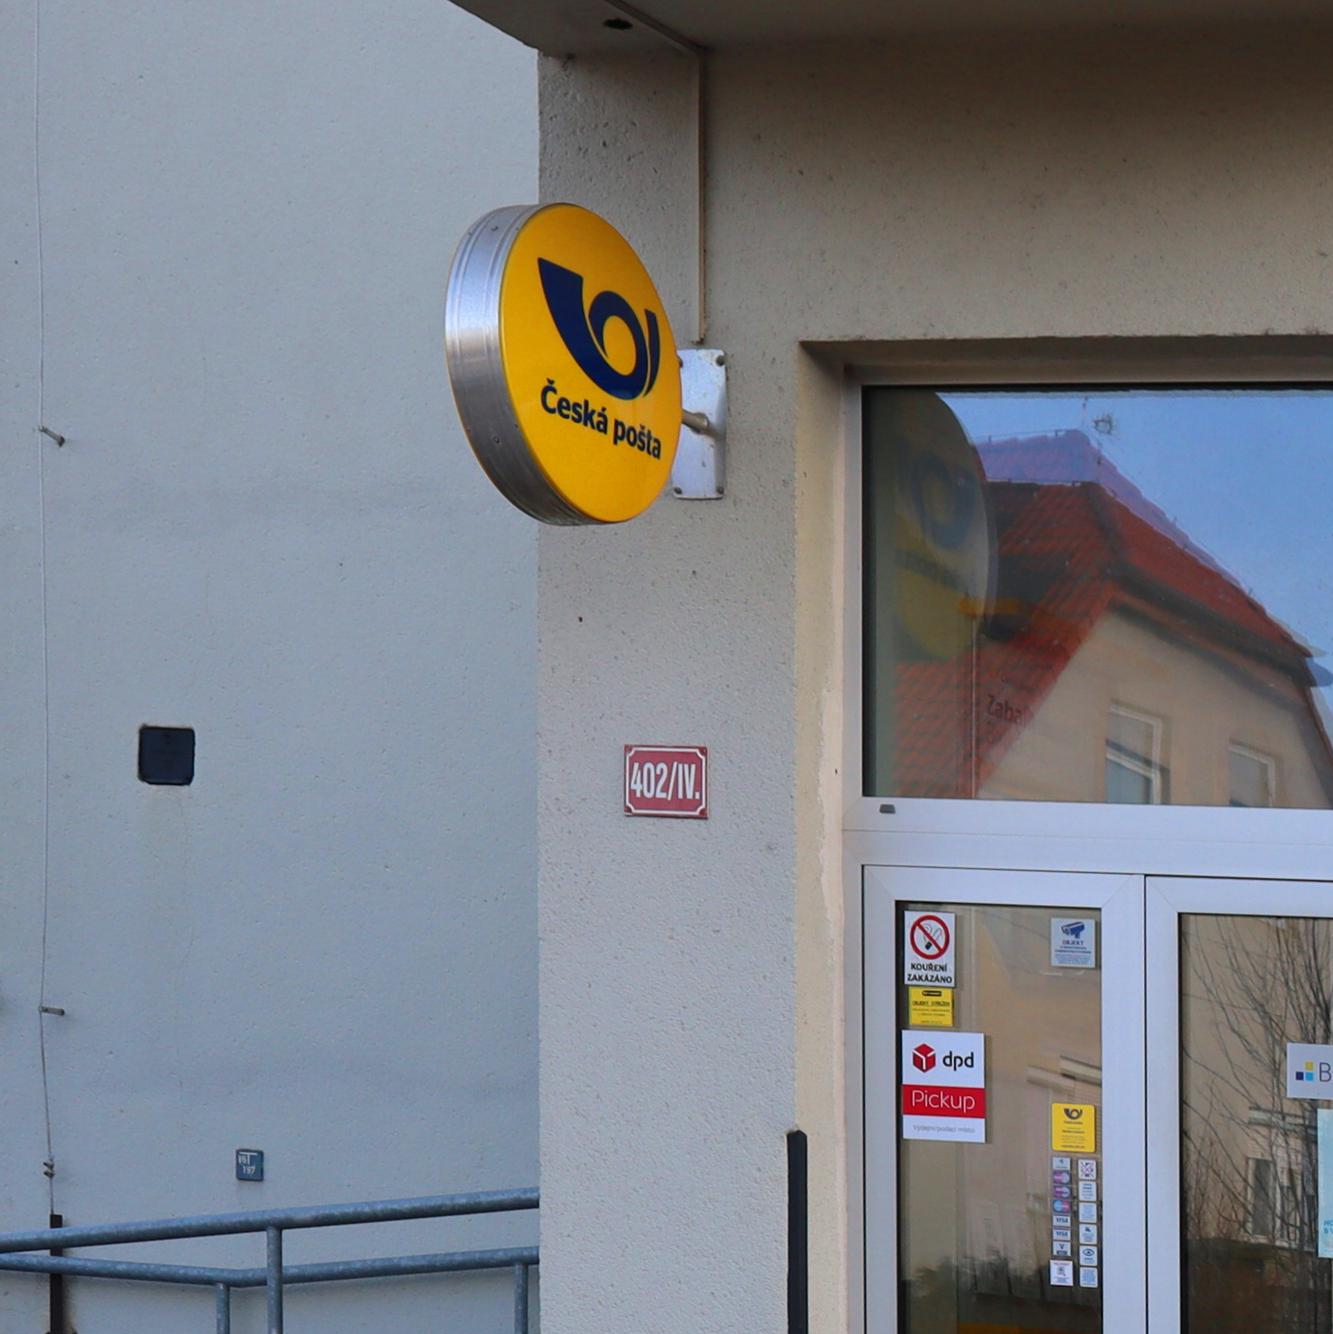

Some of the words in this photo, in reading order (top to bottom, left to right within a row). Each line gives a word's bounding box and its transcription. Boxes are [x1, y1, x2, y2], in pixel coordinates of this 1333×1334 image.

[541, 378, 608, 435] Česká
[613, 418, 661, 460] pošta
[631, 761, 700, 800] 402/IV.
[911, 962, 948, 972] KOUŘENÍ
[907, 973, 952, 984] ZAKÁZÁNO
[942, 1050, 974, 1071] dpd
[912, 1090, 976, 1113] Pickup
